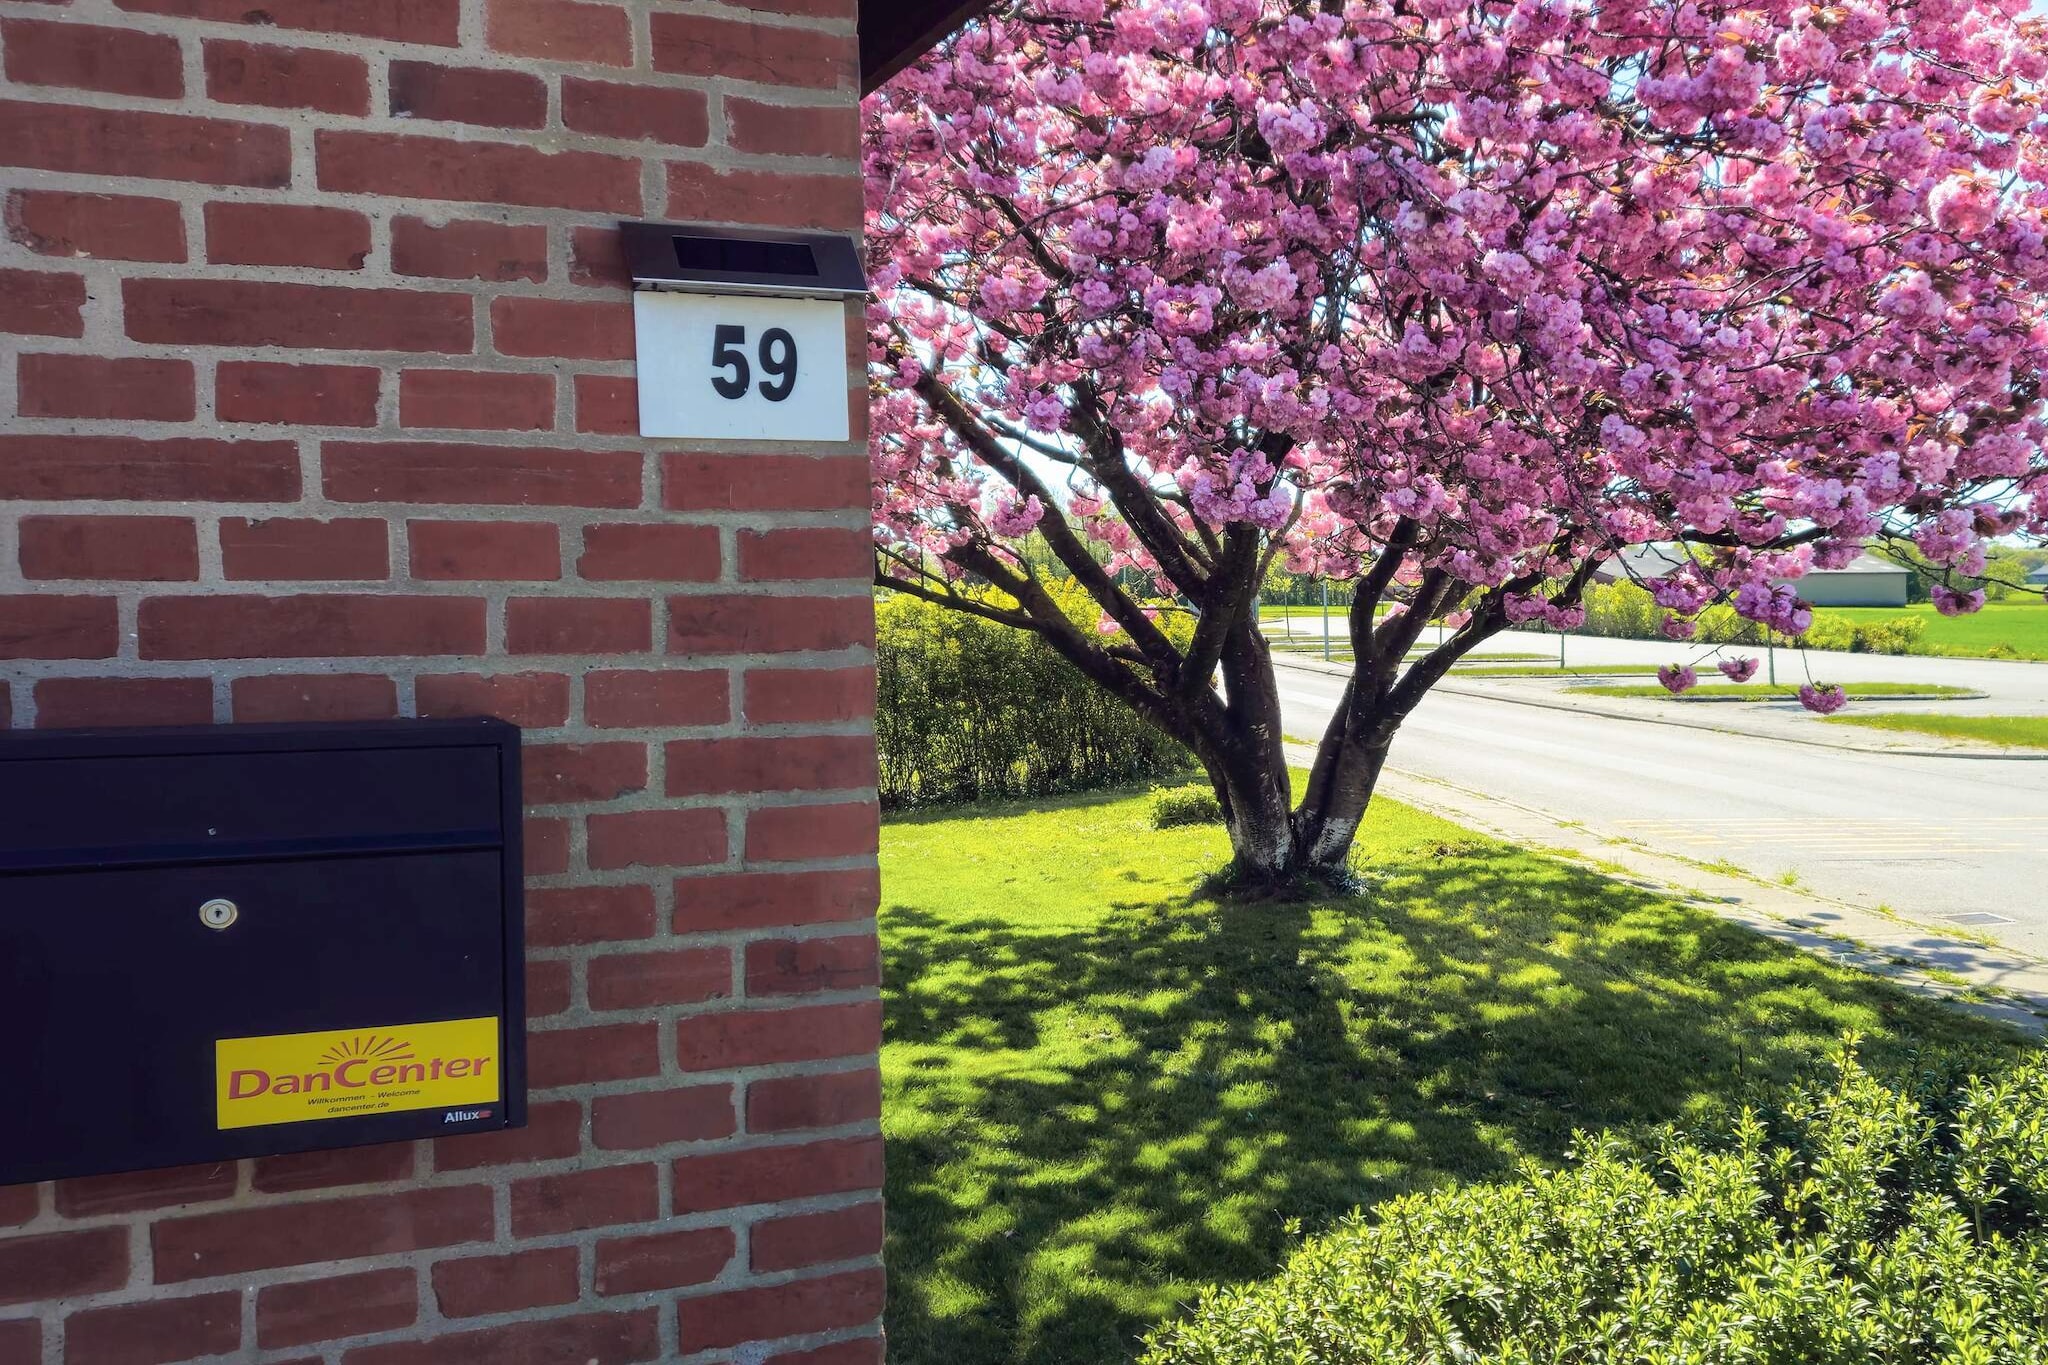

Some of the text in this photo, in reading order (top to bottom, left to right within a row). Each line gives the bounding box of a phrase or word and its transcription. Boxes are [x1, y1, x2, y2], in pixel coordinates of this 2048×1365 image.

[711, 324, 798, 402] 59
[228, 1056, 491, 1100] DanCenter
[307, 1093, 366, 1106] Willkommen
[377, 1088, 421, 1099] Welcome
[327, 1101, 390, 1114] dancenter.de
[444, 1110, 480, 1125] Allux
